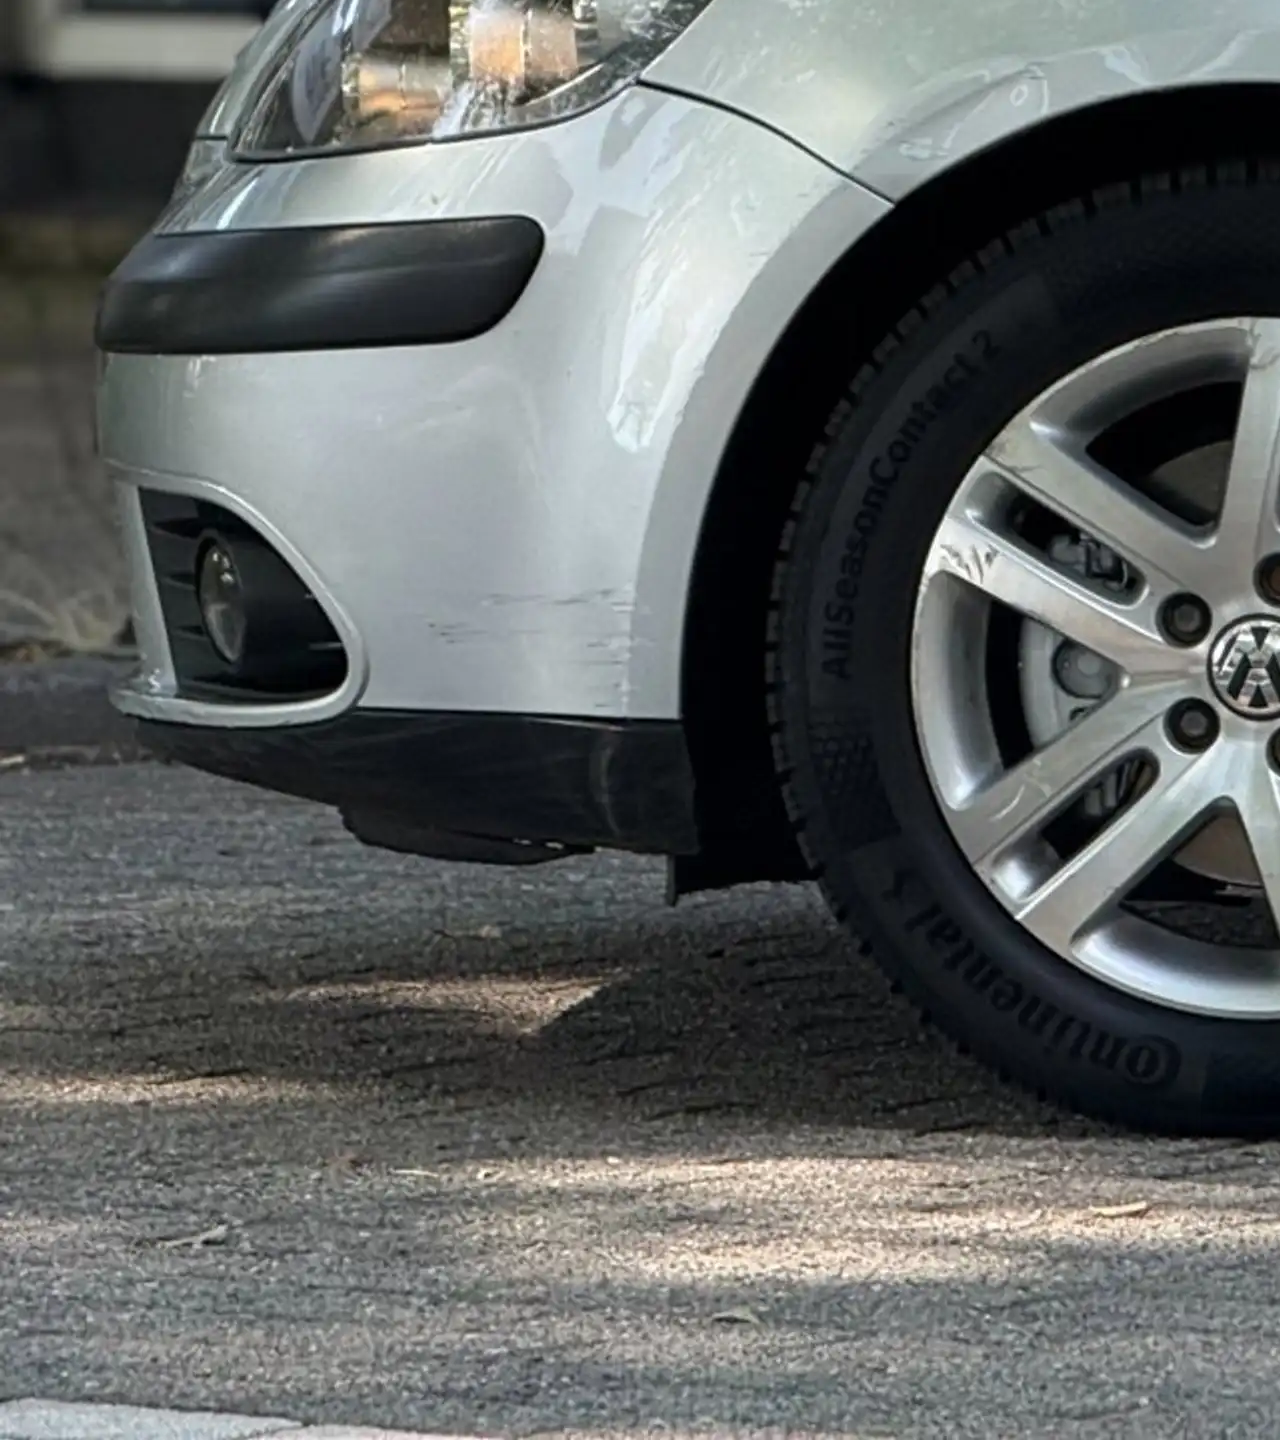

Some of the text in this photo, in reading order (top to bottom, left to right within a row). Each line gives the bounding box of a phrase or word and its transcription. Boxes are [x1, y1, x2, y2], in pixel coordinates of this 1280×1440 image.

[822, 329, 1002, 681] AllSeasonContact 2
[904, 902, 1182, 1088] Continental
